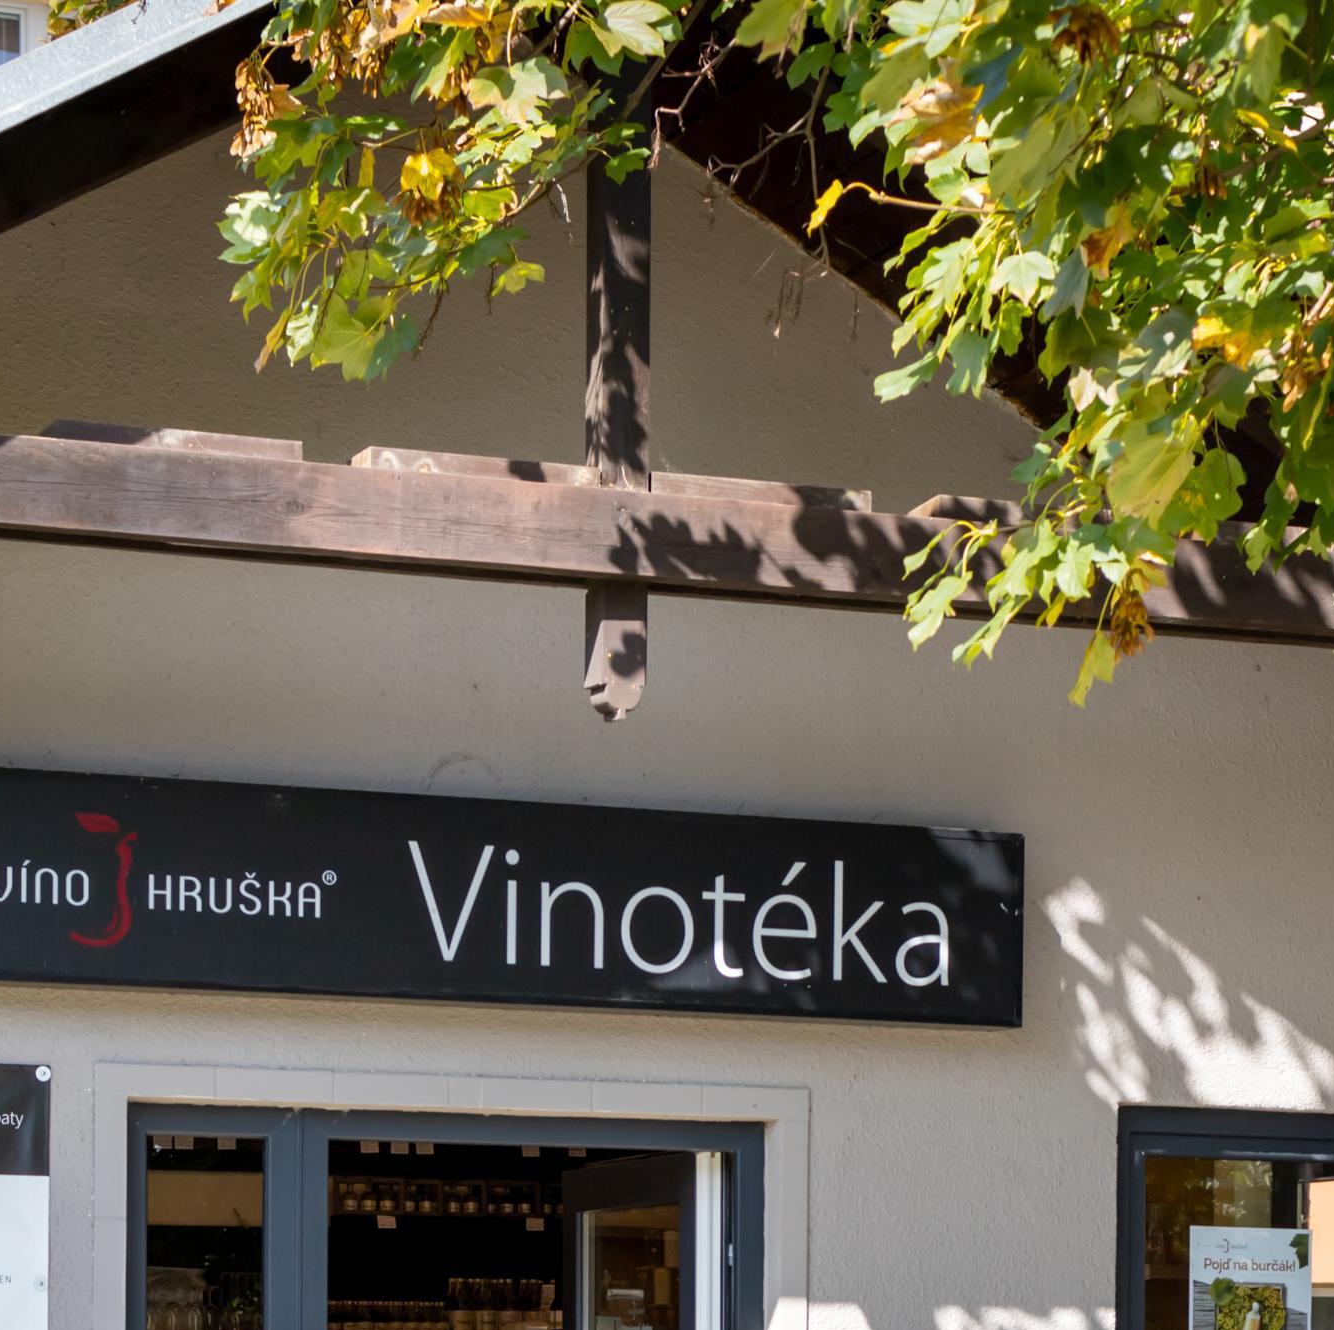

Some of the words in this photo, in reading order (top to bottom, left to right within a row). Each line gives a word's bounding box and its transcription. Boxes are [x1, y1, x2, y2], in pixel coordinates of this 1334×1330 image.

[407, 839, 950, 987] Vinotéka
[1233, 1261, 1248, 1270] na
[1251, 1258, 1296, 1272] burčák!
